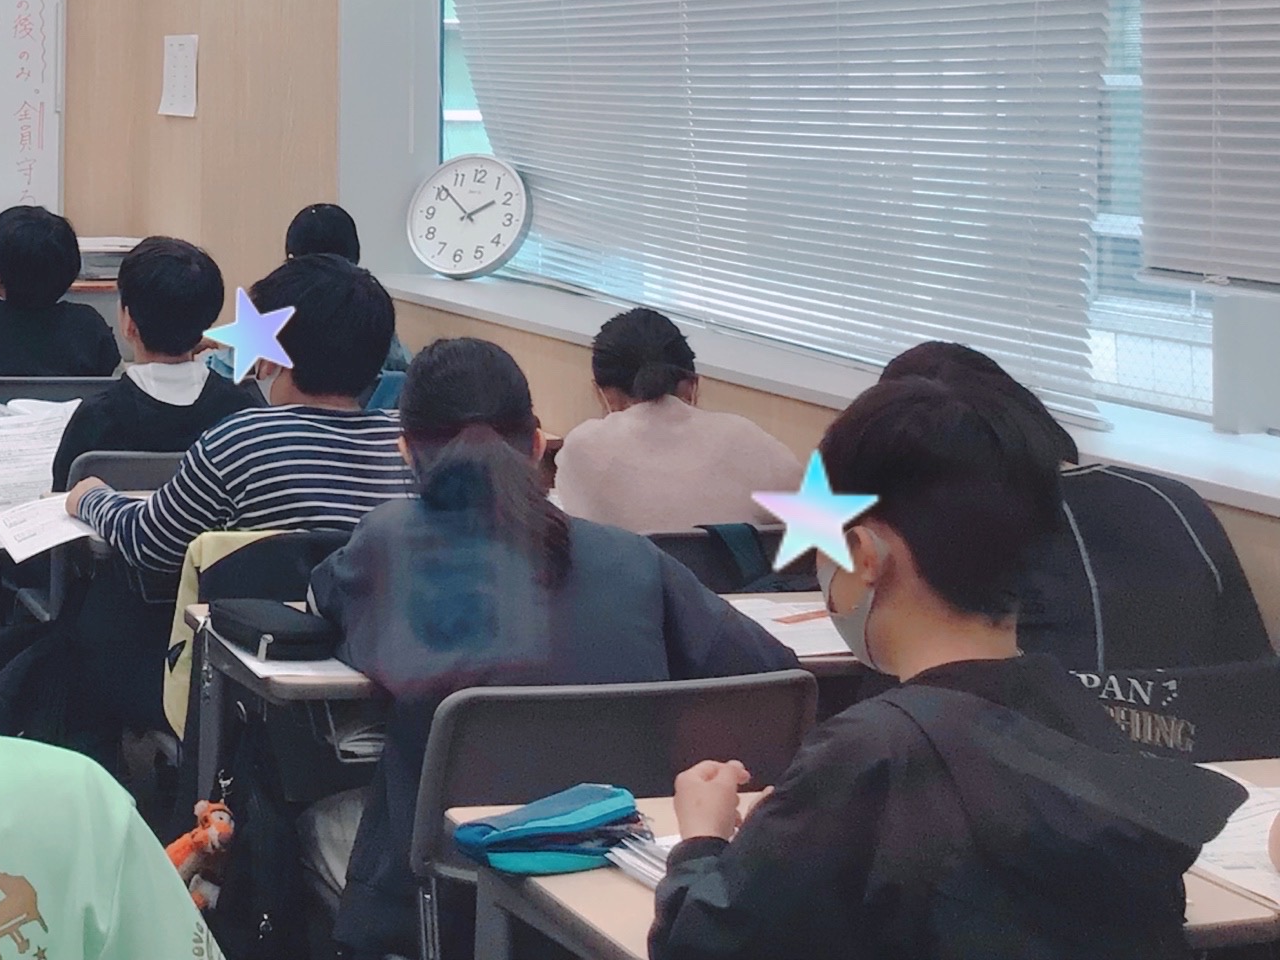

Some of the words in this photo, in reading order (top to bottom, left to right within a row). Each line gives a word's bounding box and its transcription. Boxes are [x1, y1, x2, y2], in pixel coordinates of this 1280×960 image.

[453, 173, 466, 187] 11
[473, 169, 487, 184] 12
[495, 176, 501, 190] 1
[435, 187, 449, 201] 10
[502, 191, 513, 206] 2
[425, 206, 436, 220] 9
[502, 213, 513, 227] 3
[425, 226, 437, 240] 8
[490, 233, 501, 247] 4
[437, 242, 447, 255] 7
[473, 246, 484, 260] 5
[452, 249, 464, 263] 6
[1069, 670, 1154, 706] PAN
